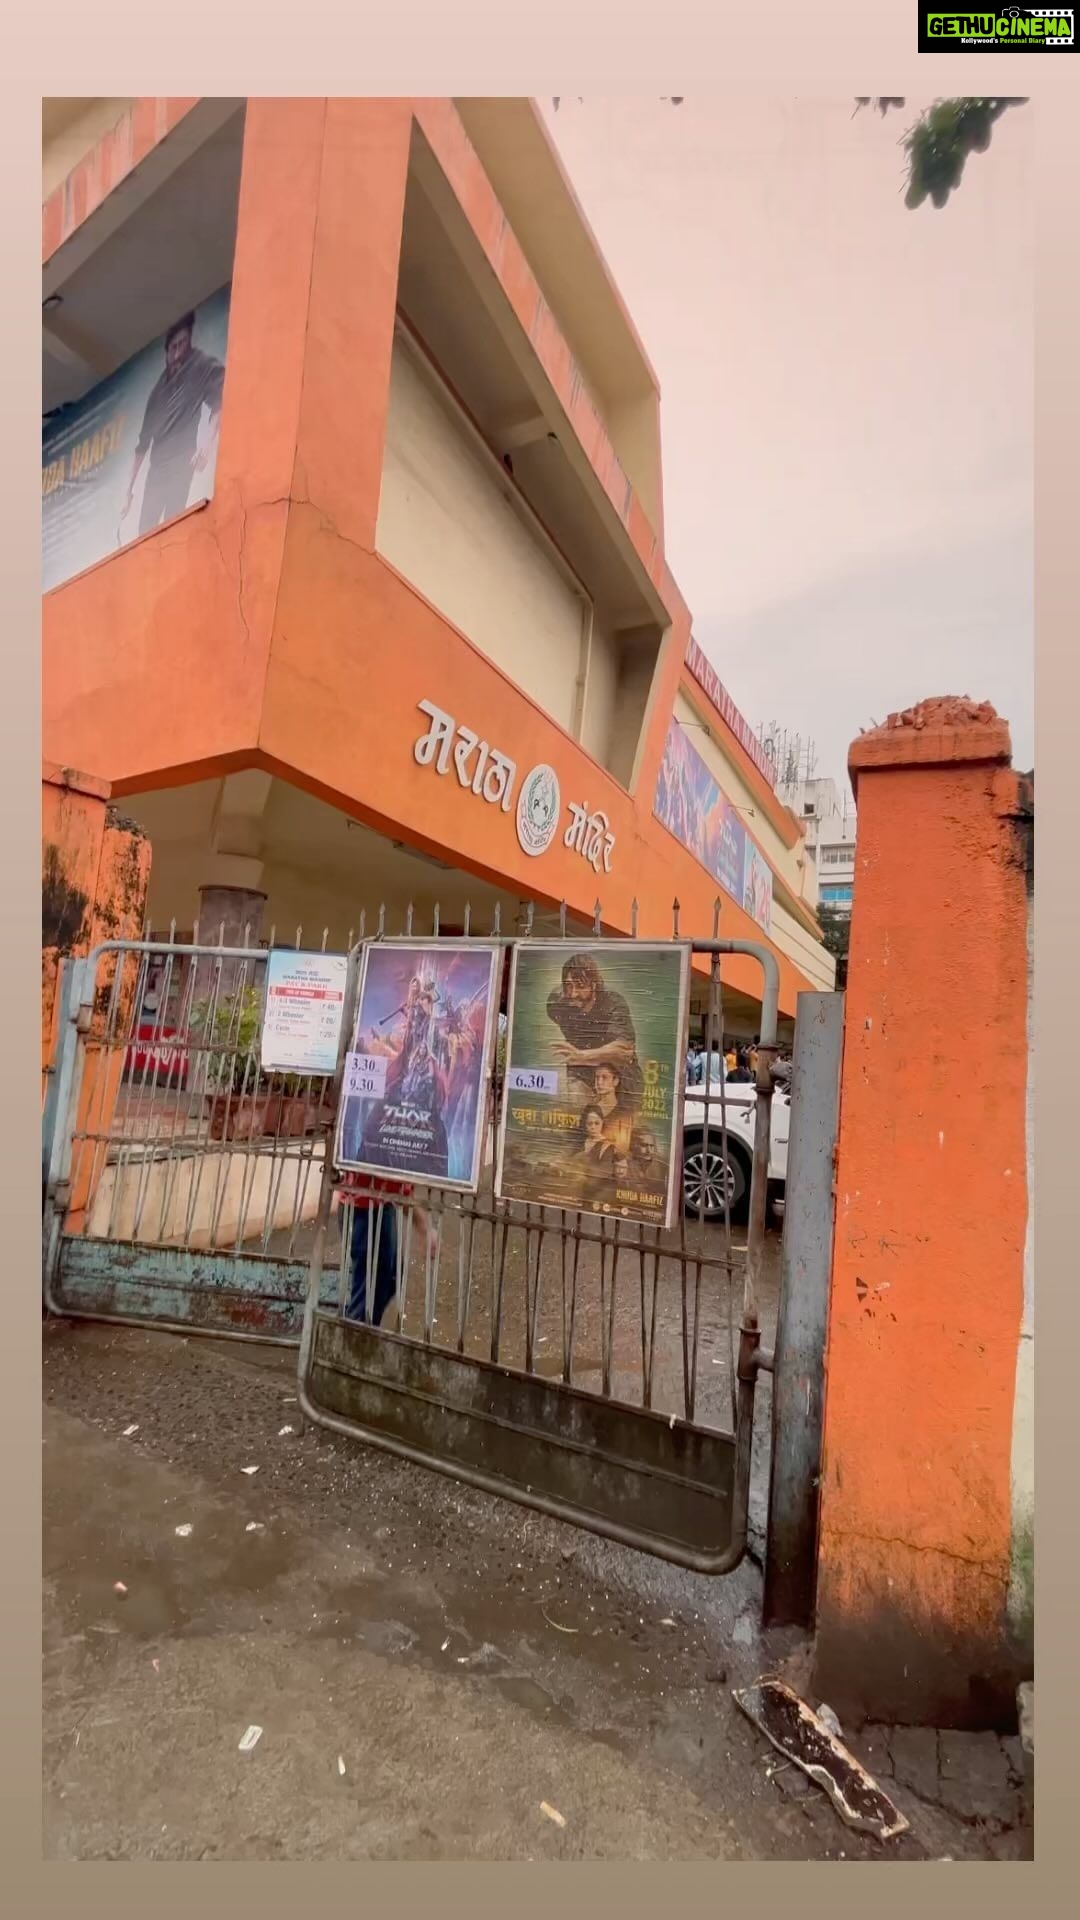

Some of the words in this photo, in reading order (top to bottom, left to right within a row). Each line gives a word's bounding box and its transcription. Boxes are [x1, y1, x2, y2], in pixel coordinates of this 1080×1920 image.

[684, 635, 745, 742] MARATHA
[414, 698, 517, 813] मराठा
[564, 800, 616, 873] मंदिर
[515, 1074, 544, 1089] 6.30
[384, 1104, 432, 1122] THOR
